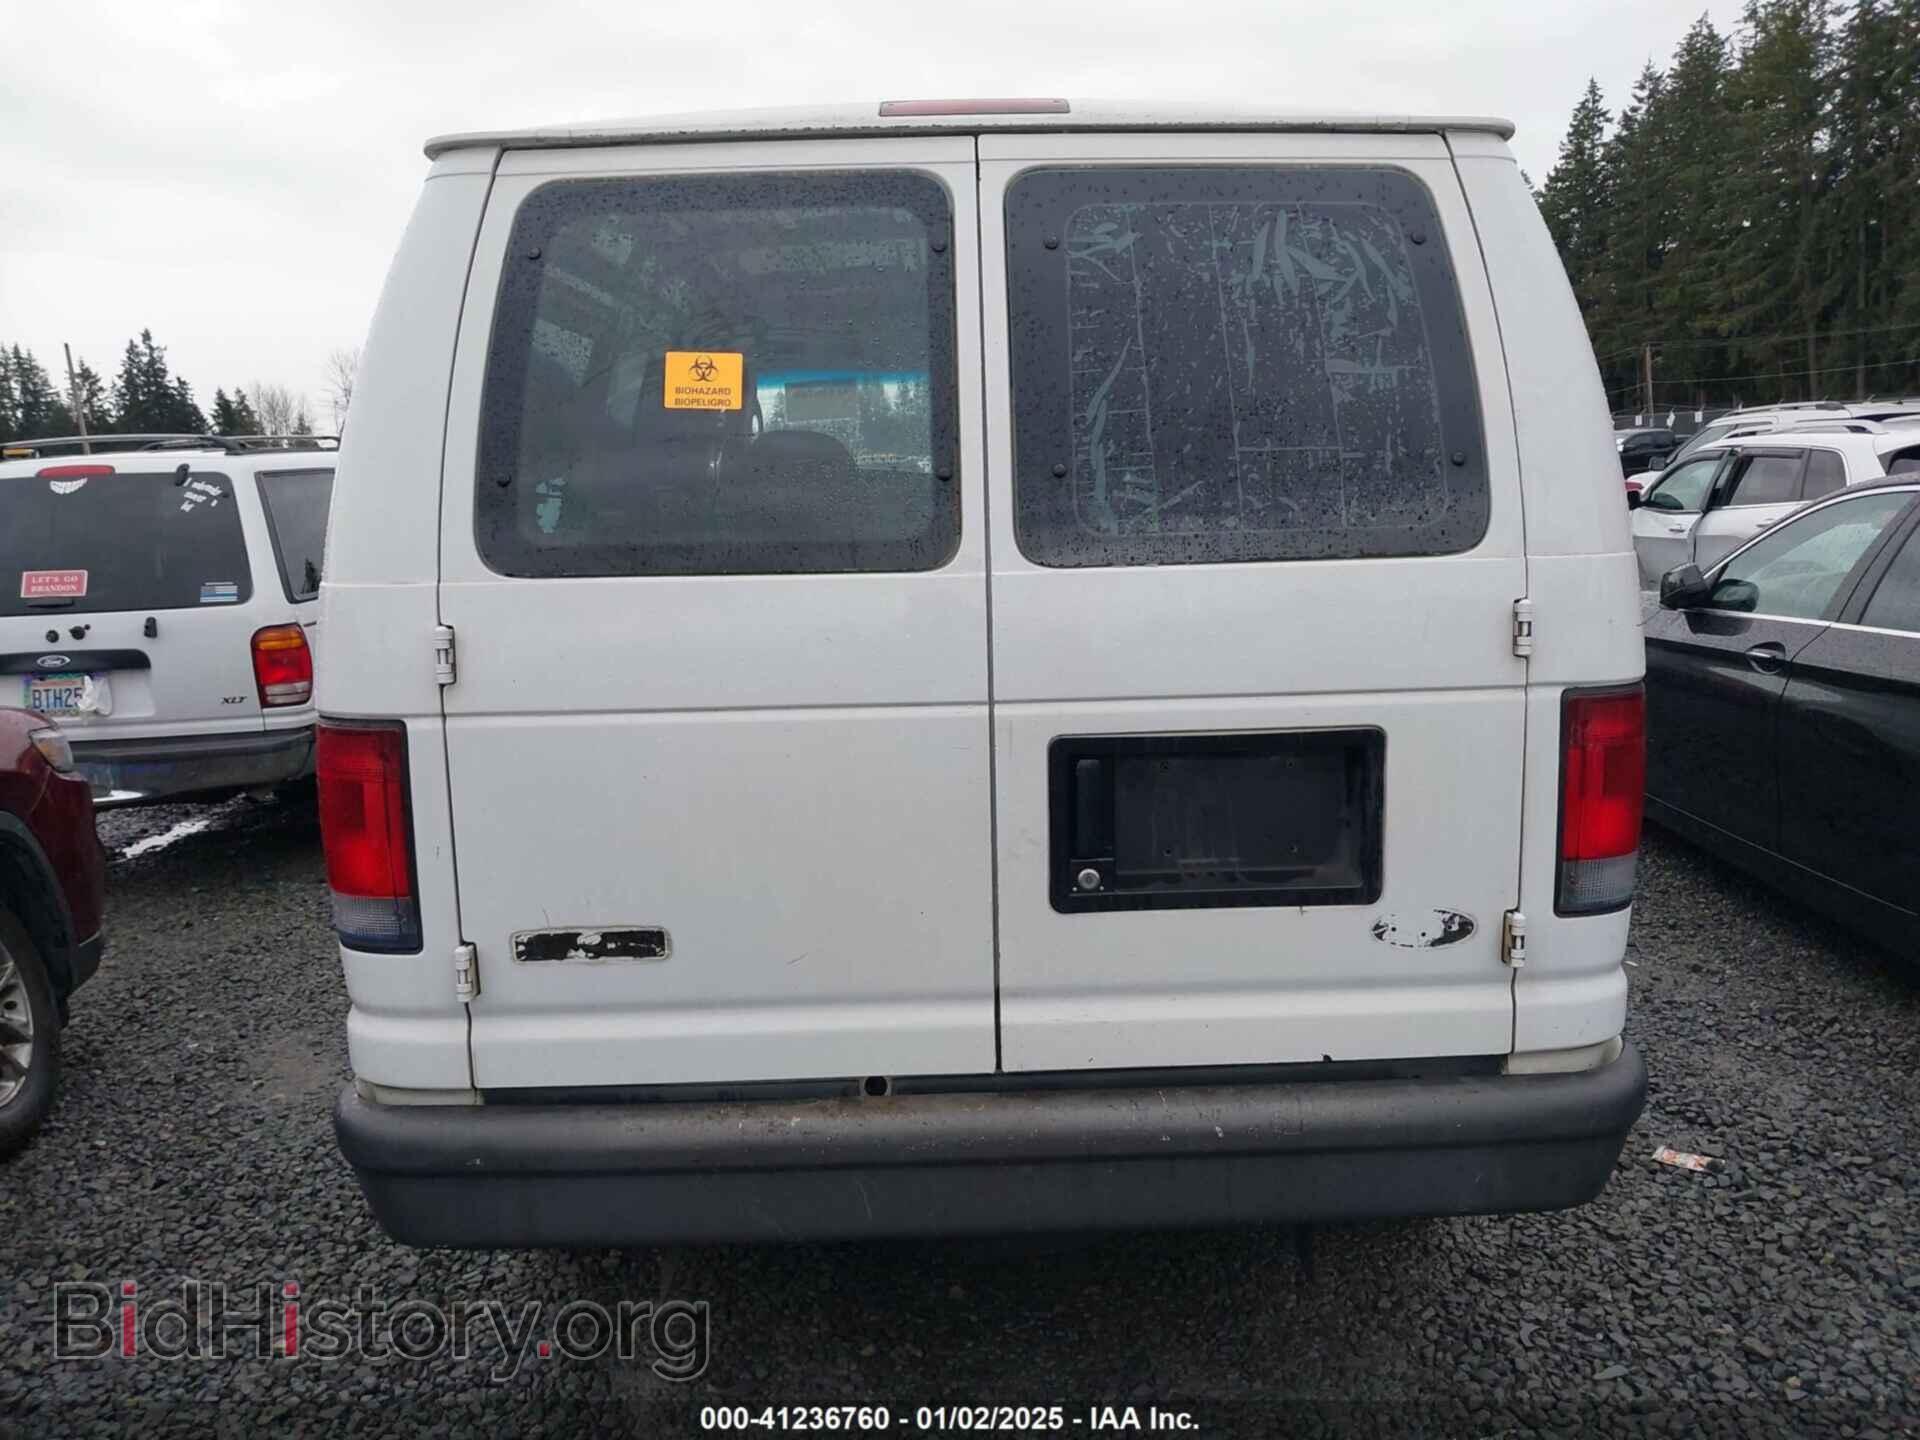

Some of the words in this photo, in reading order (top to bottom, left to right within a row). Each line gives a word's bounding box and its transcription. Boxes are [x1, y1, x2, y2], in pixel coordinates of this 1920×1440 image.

[675, 386, 731, 395] BIOHAZARD
[674, 398, 731, 407] BIOPELIGRO
[32, 575, 60, 584] LET'S
[63, 575, 79, 583] GO
[31, 584, 78, 593] BRANDON
[220, 696, 248, 705] XLT
